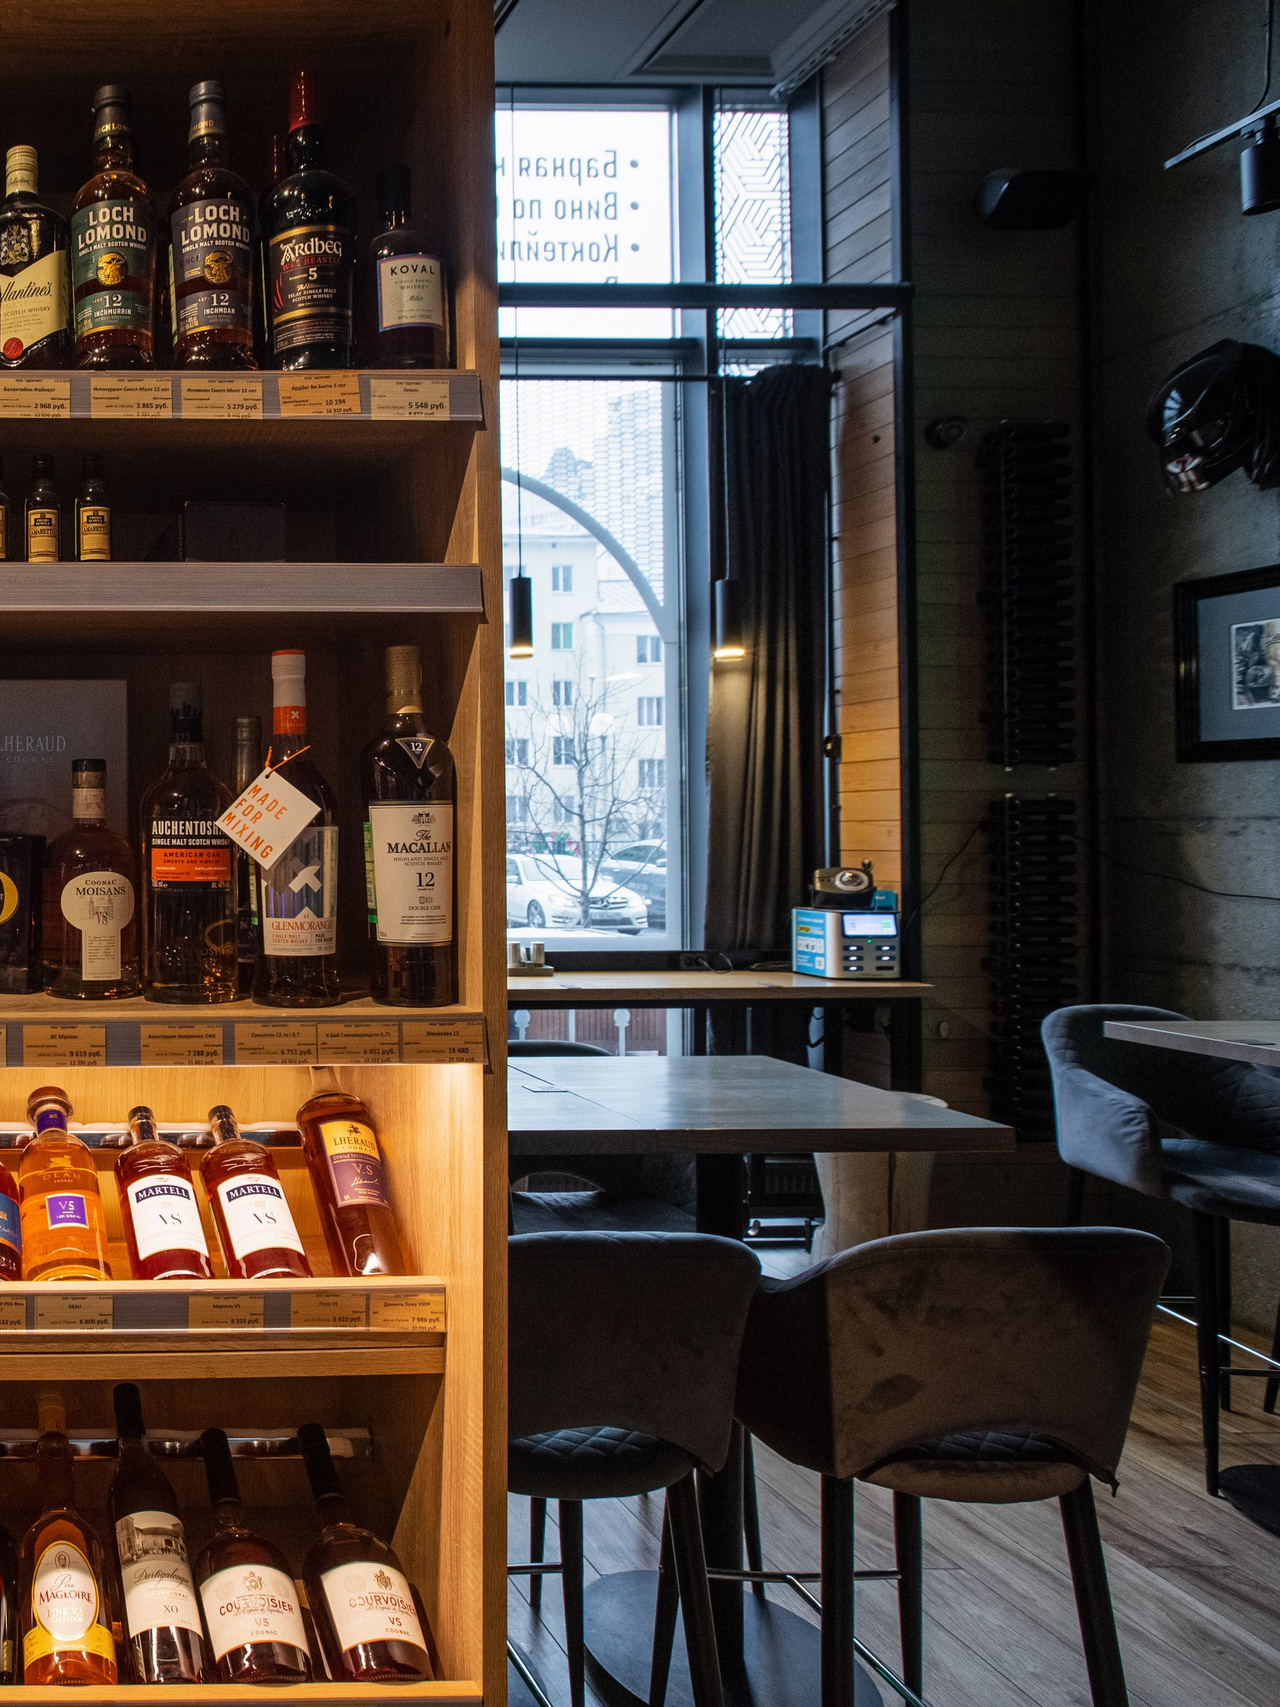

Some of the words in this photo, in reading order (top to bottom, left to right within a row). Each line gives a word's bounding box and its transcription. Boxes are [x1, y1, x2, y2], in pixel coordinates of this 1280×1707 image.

[88, 206, 134, 226] LOCH
[194, 205, 240, 223] LOCH
[78, 224, 147, 249] LOMOND
[181, 222, 250, 246] LOMOND
[94, 242, 107, 251] MALT
[308, 267, 317, 280] 5
[391, 264, 435, 276] KOVAL
[104, 294, 122, 307] 12
[211, 293, 229, 306] 12
[411, 742, 422, 751] 12
[247, 784, 288, 820] MADE
[235, 798, 263, 825] FOR
[222, 811, 273, 859] MIXING
[152, 838, 170, 846] SINGLE
[171, 838, 187, 846] MALT
[188, 838, 210, 846] SCOTCH
[387, 842, 451, 854] MACALLAN
[416, 872, 435, 888] 12
[76, 887, 126, 896] MOISANS
[333, 1136, 375, 1151] LHERAUD
[138, 1186, 188, 1201] MARTELL
[230, 1185, 280, 1199] MARTELL
[58, 1201, 74, 1211] VS
[159, 1213, 182, 1225] VS
[253, 1212, 277, 1224] VS
[39, 1589, 94, 1605] MAGLOIRE
[164, 1605, 178, 1614] XO
[219, 1596, 294, 1616] COURVOISIER
[254, 1618, 270, 1627] VS
[388, 1616, 403, 1627] VS
